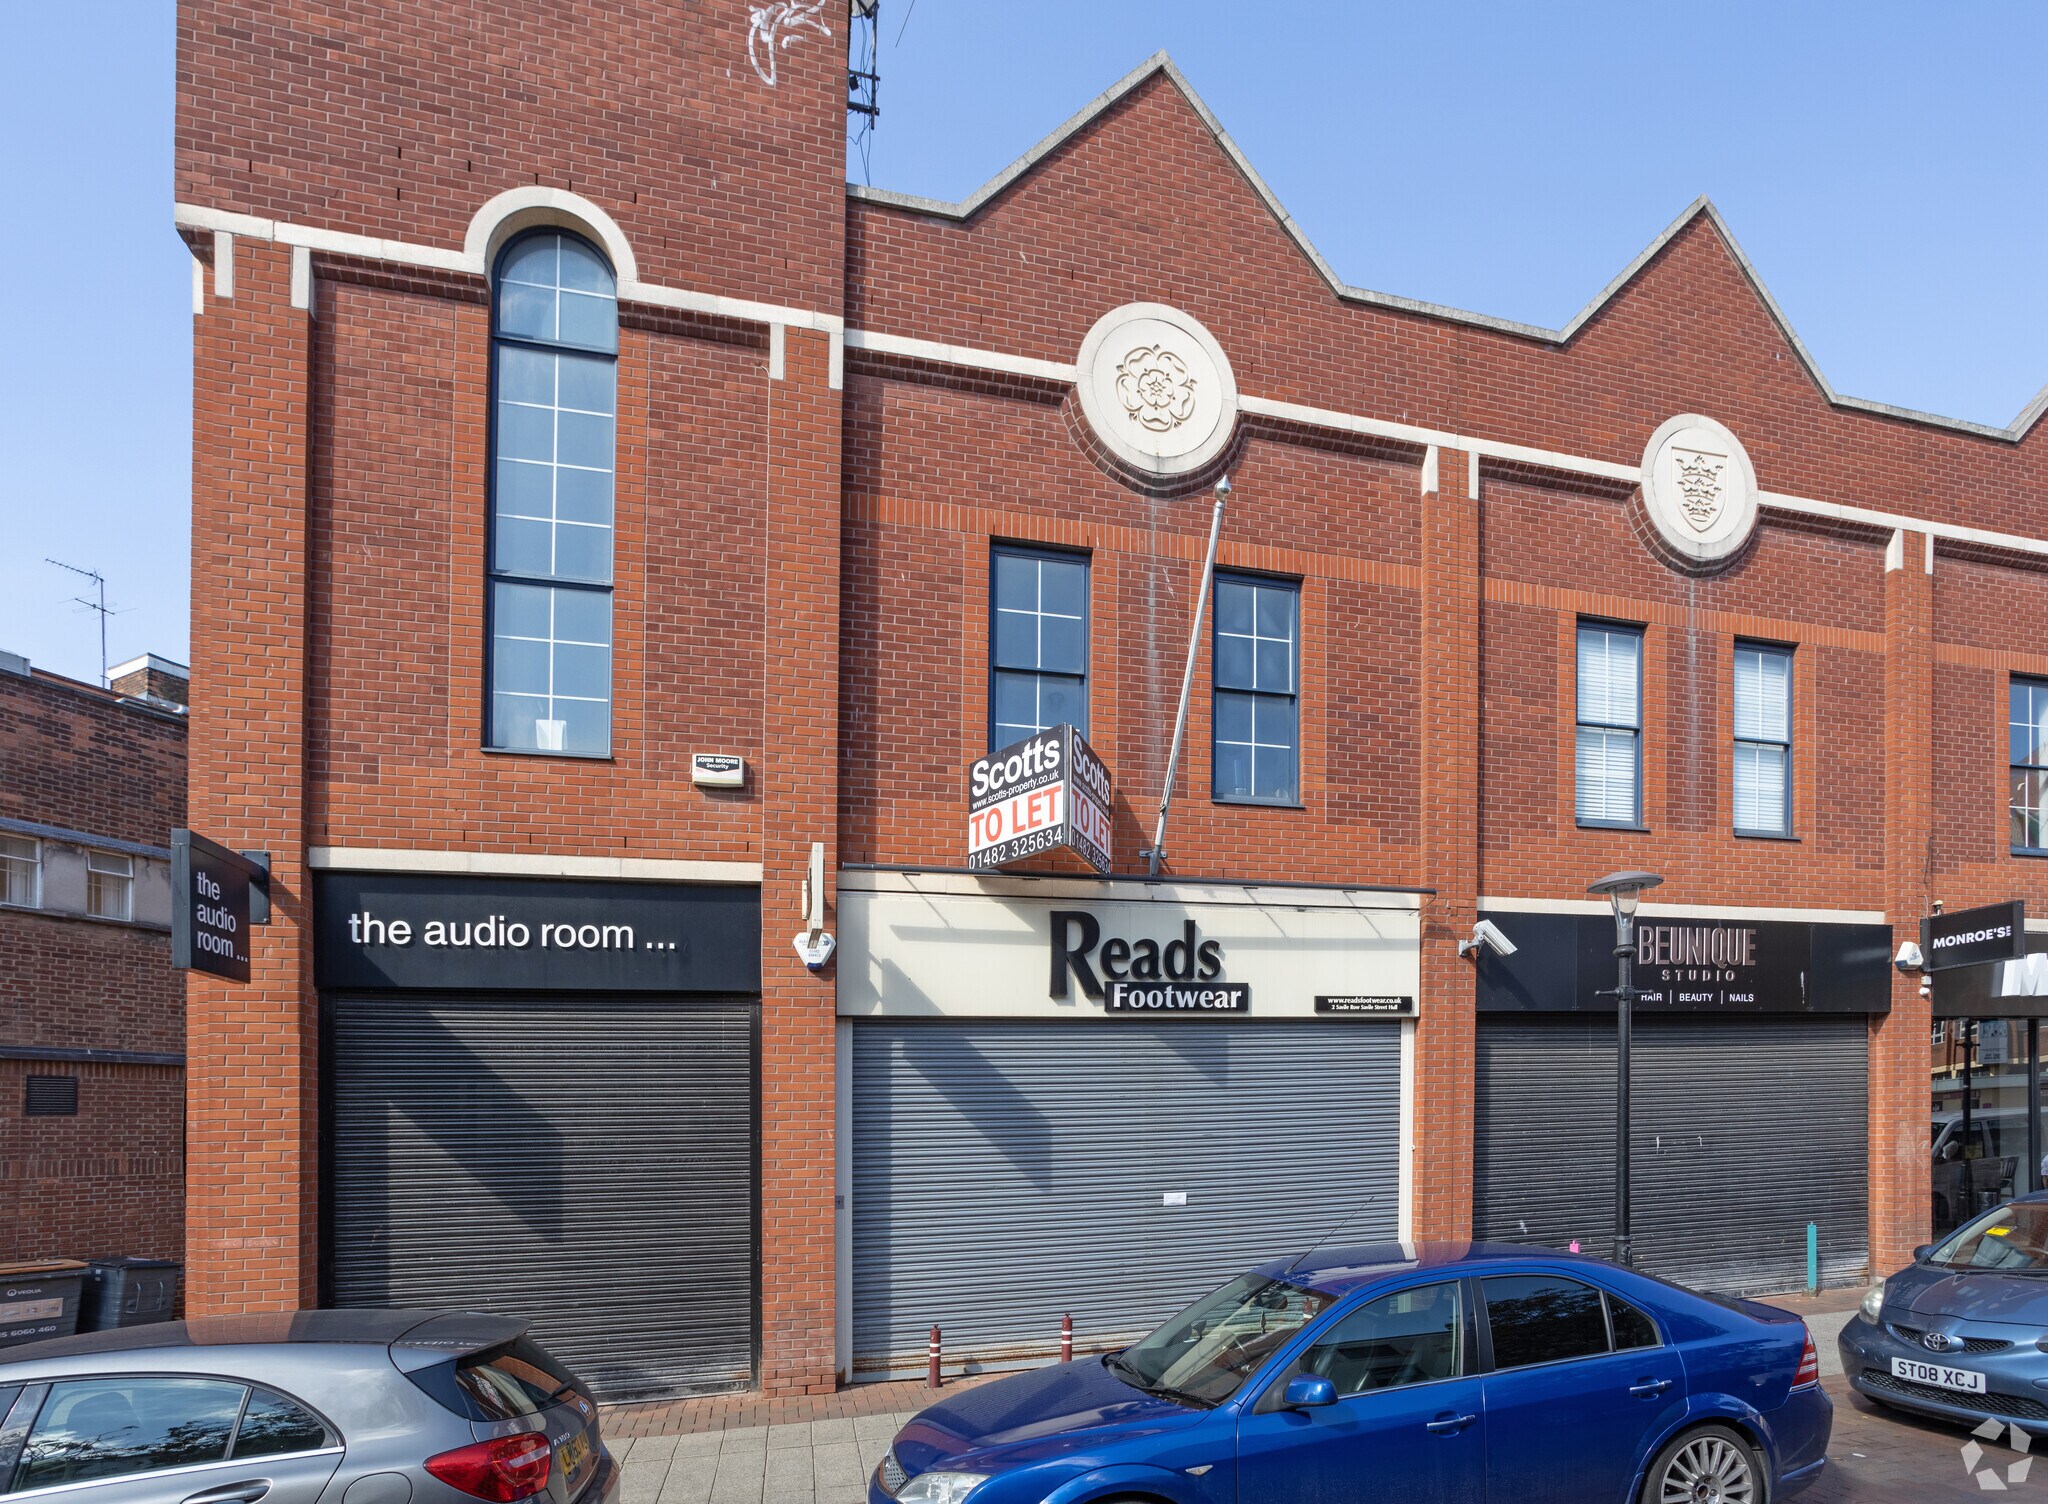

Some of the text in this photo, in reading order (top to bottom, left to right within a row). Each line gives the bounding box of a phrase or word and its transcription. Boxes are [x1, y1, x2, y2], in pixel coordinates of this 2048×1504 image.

[715, 757, 739, 765] MOORE
[972, 737, 1060, 797] Scotts
[1073, 734, 1110, 806] Scotts
[972, 769, 1060, 811] www.scotts-property.co.uk
[971, 784, 1062, 848] TO LET
[1072, 790, 1110, 854] TO LET
[969, 826, 1063, 870] 01482 325634
[1071, 829, 1091, 859] 01482
[196, 871, 221, 901] the
[196, 903, 237, 933] audio
[348, 911, 411, 945] the
[423, 915, 530, 947] audio
[540, 923, 634, 949] room
[197, 930, 234, 958] room
[1639, 926, 1756, 969] BEUNIQUE
[1932, 926, 2006, 950] MONROE'S
[1049, 910, 1222, 1000] Reads
[1661, 969, 1736, 982] STUDIO
[1113, 983, 1242, 1009] Footwear
[1327, 996, 1402, 1004] www.readsfootwear.co.uk
[1641, 993, 1754, 1003] HAIR BEAUTY NAILS
[10, 1328, 36, 1337] 6060
[37, 1325, 57, 1333] 460
[1898, 1361, 1978, 1389] ST08 XCJ
